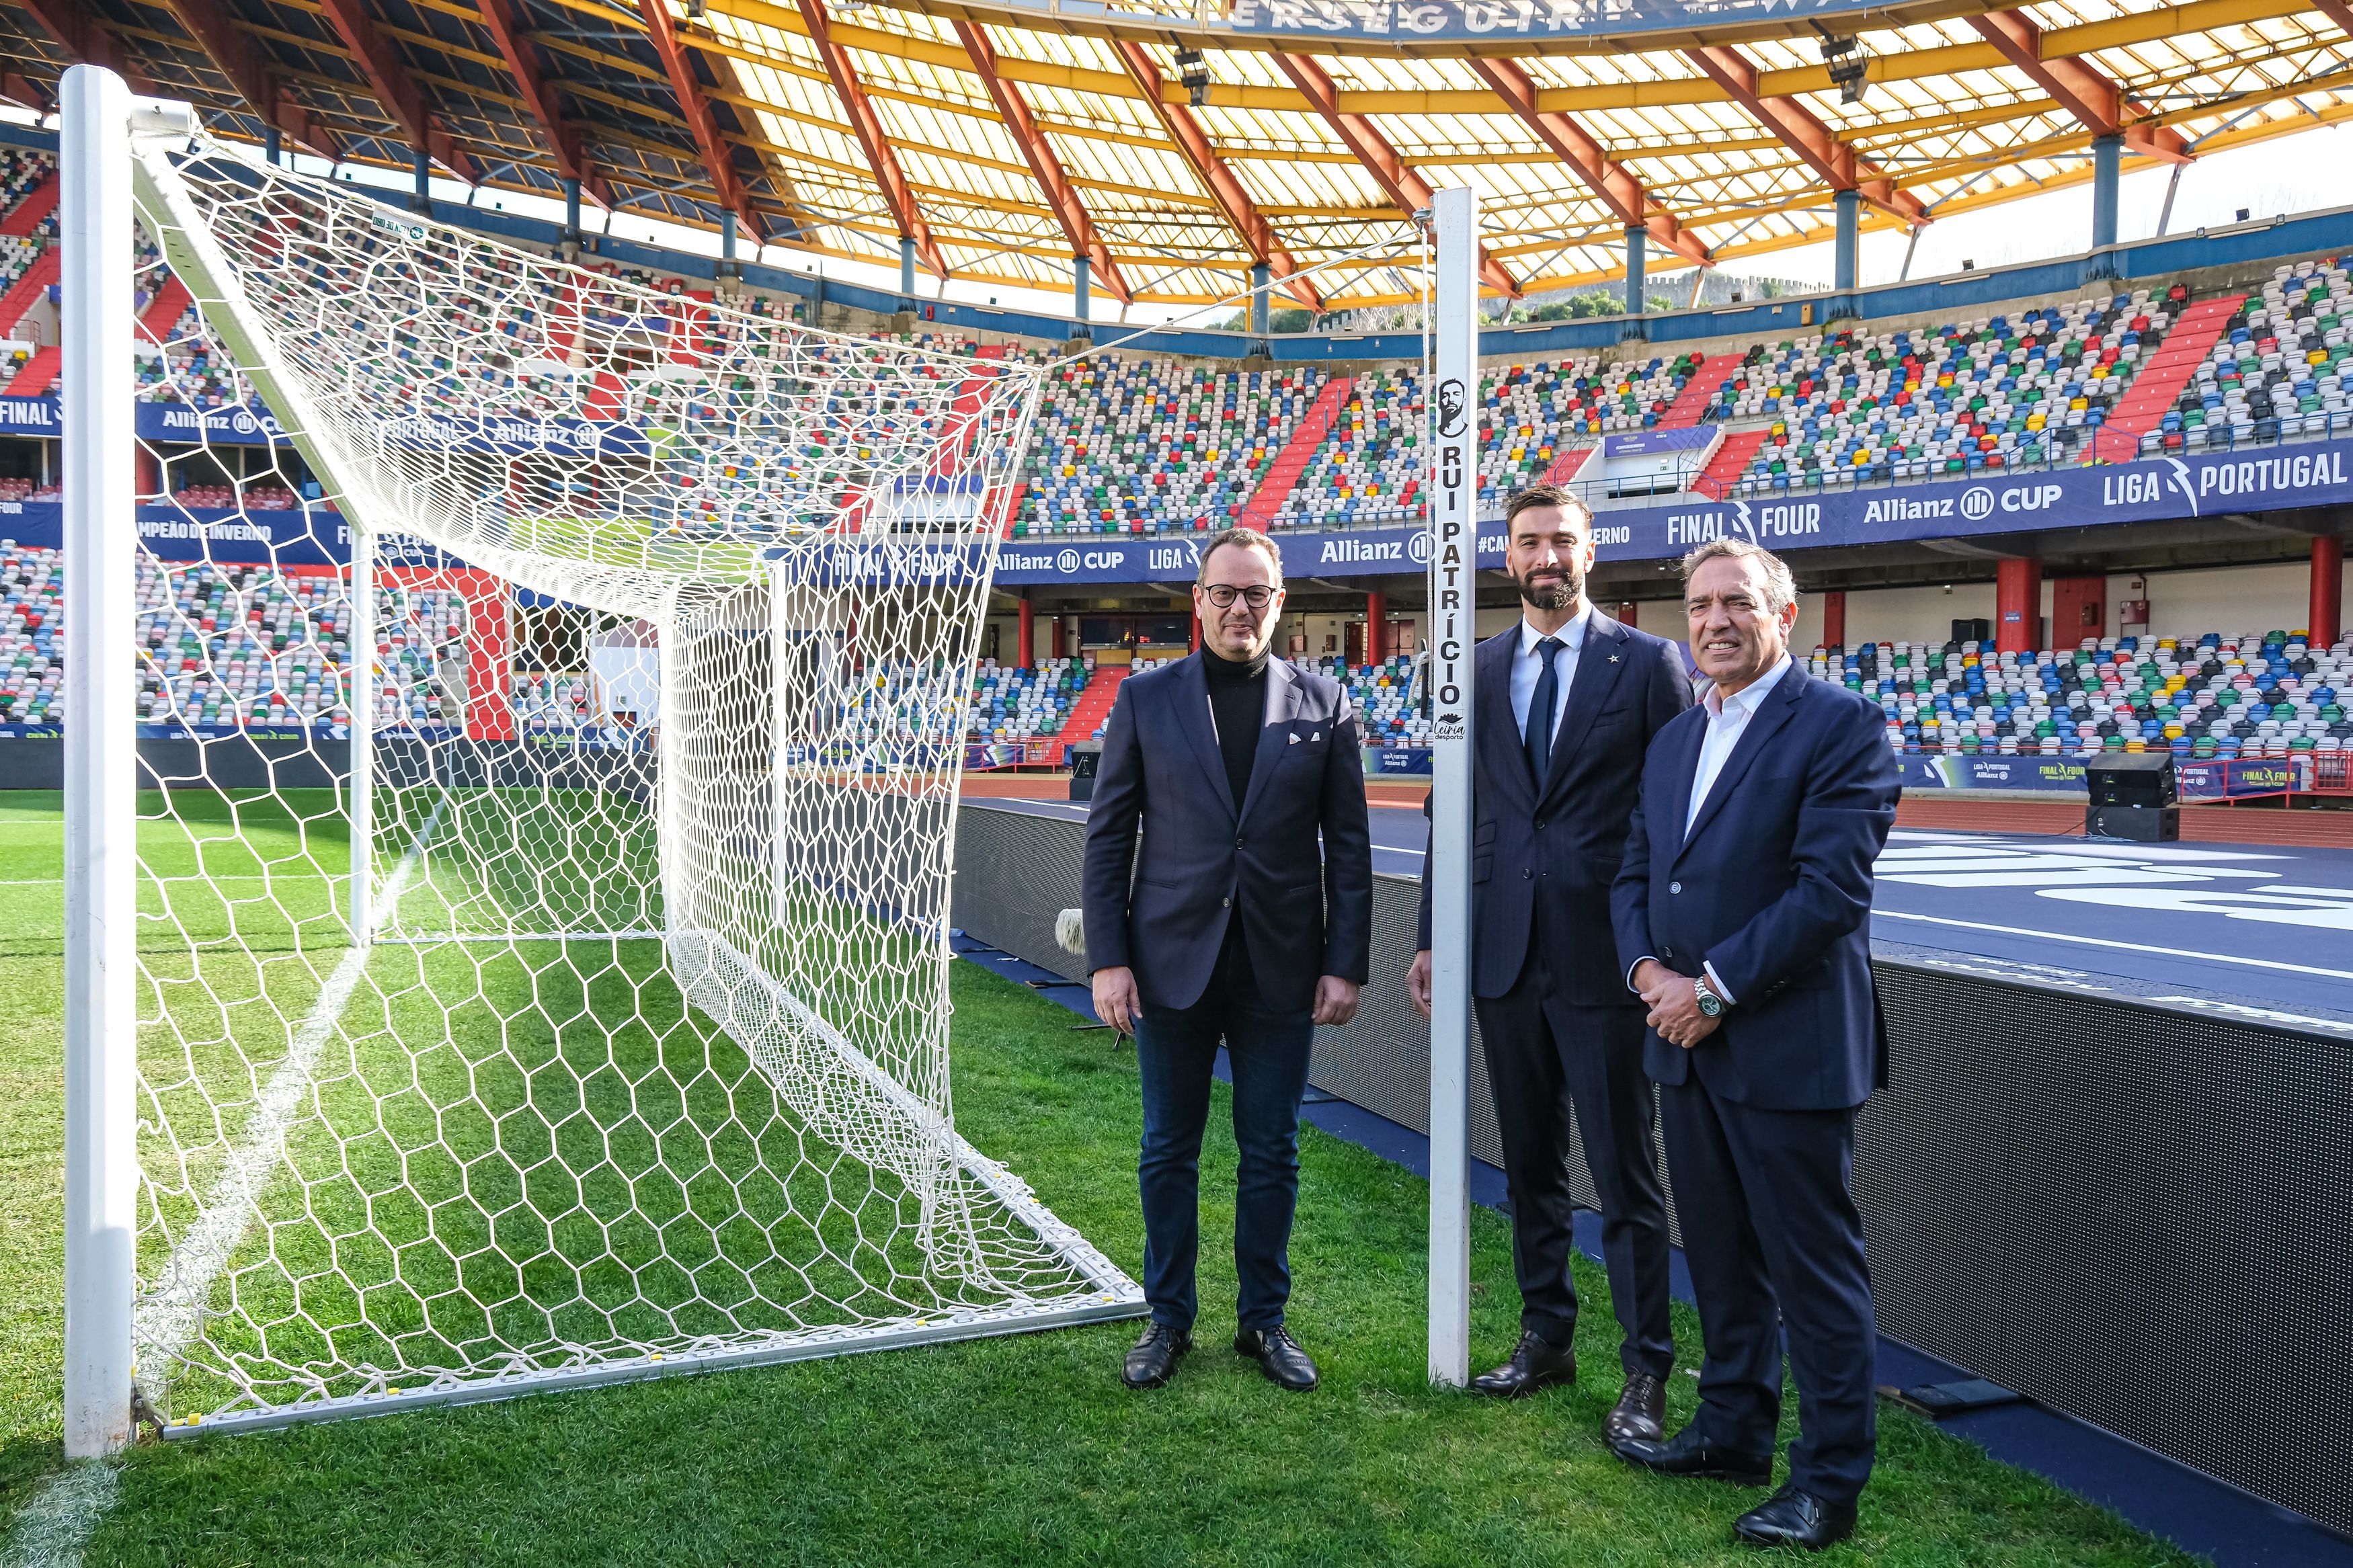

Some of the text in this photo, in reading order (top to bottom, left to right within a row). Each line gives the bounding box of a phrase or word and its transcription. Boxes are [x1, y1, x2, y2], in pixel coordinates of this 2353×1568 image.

[0, 401, 53, 425] FINAL
[162, 411, 230, 429] Allianz
[493, 423, 570, 444] Allianz
[2104, 452, 2348, 505] LIGA PORTUGAL
[1863, 485, 2063, 523] Allianz CUP
[1667, 503, 1820, 544] FINAL FOUR
[994, 551, 1125, 571] Allianz CUP
[1149, 548, 1183, 569] LIGA
[1320, 539, 1402, 563] Allianz
[1439, 446, 1462, 705] RUI PATRÍCIO
[2039, 766, 2085, 776] FINAL FOUR
[2242, 771, 2264, 781] FINAL
